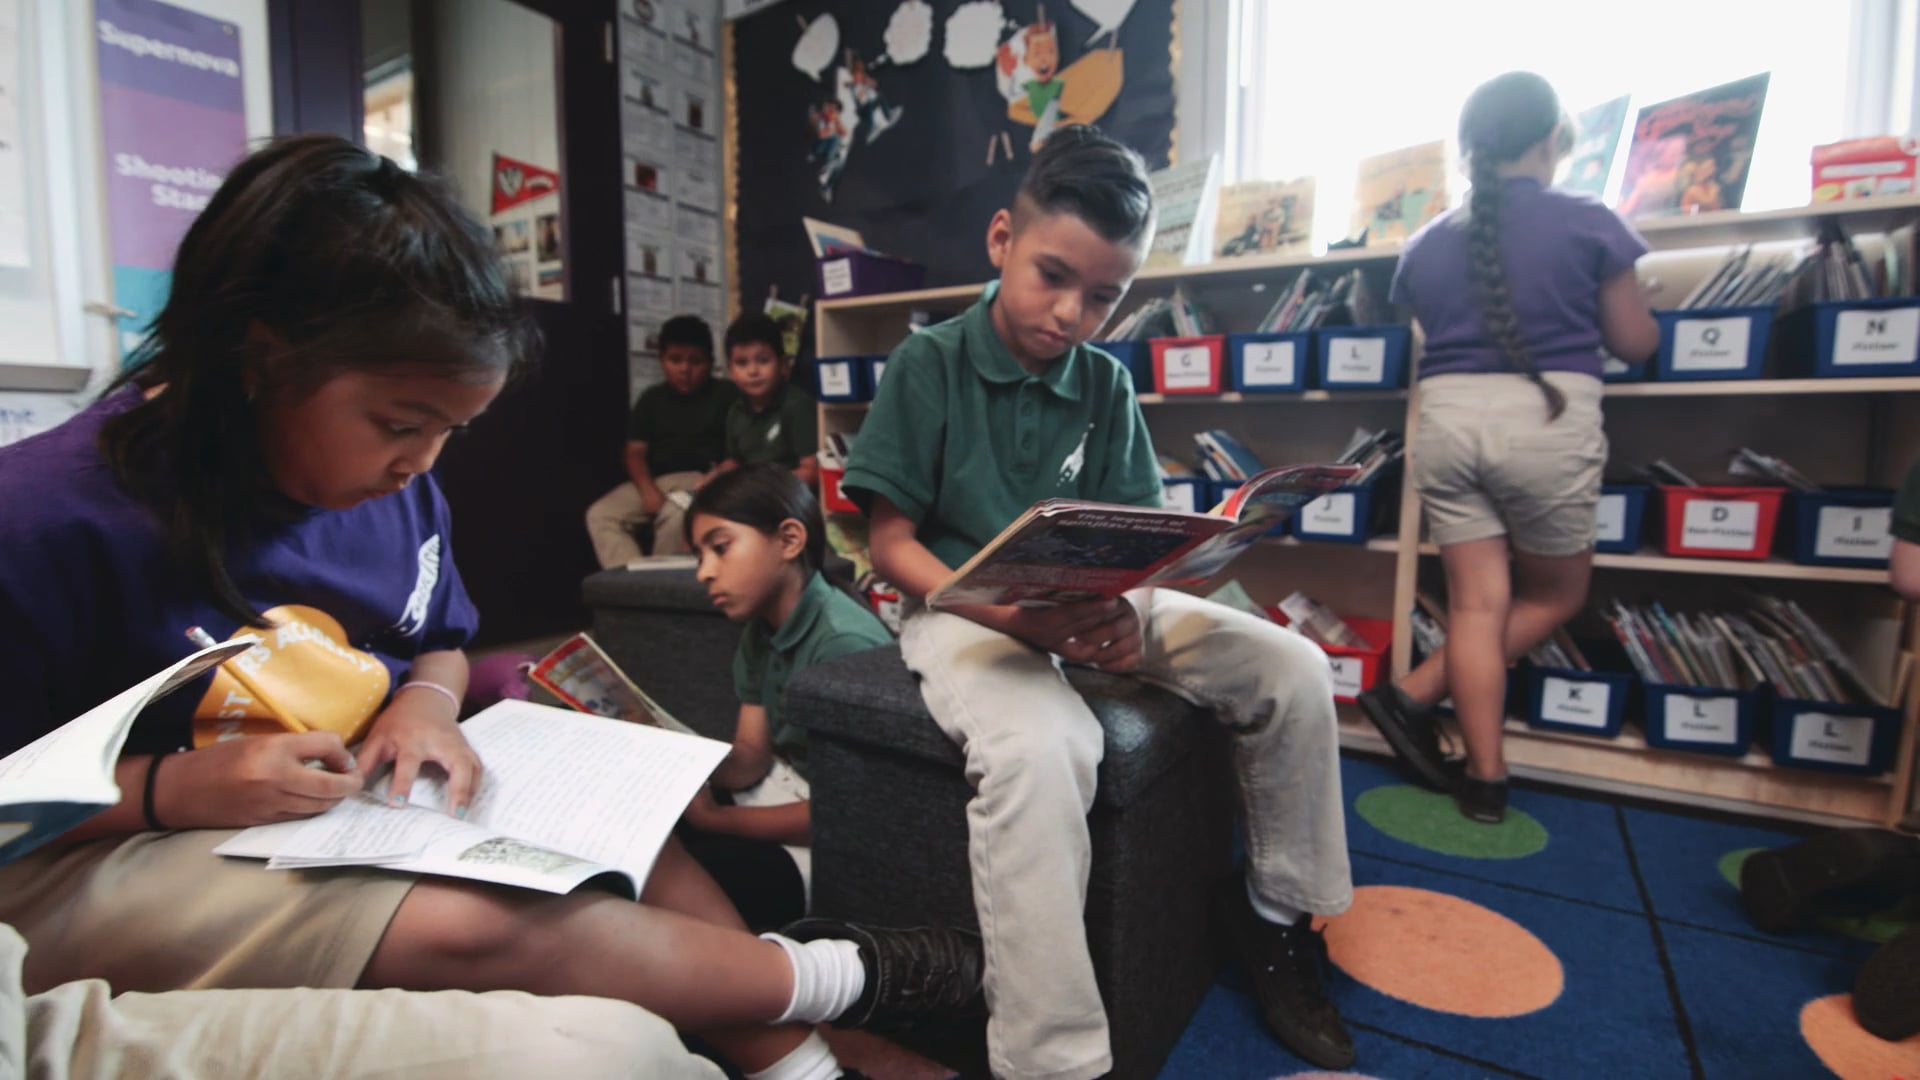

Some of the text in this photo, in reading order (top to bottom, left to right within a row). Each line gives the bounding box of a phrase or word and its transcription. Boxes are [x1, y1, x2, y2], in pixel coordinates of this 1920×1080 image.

[99, 20, 239, 78] Supernova
[114, 153, 224, 190] Shootin
[1866, 318, 1887, 335] N
[1701, 326, 1721, 347] Q
[1262, 348, 1273, 362] J
[1351, 344, 1362, 360] L
[1711, 506, 1729, 522] D
[1568, 687, 1582, 701] K
[1694, 701, 1709, 719] L
[1824, 721, 1840, 737] L
